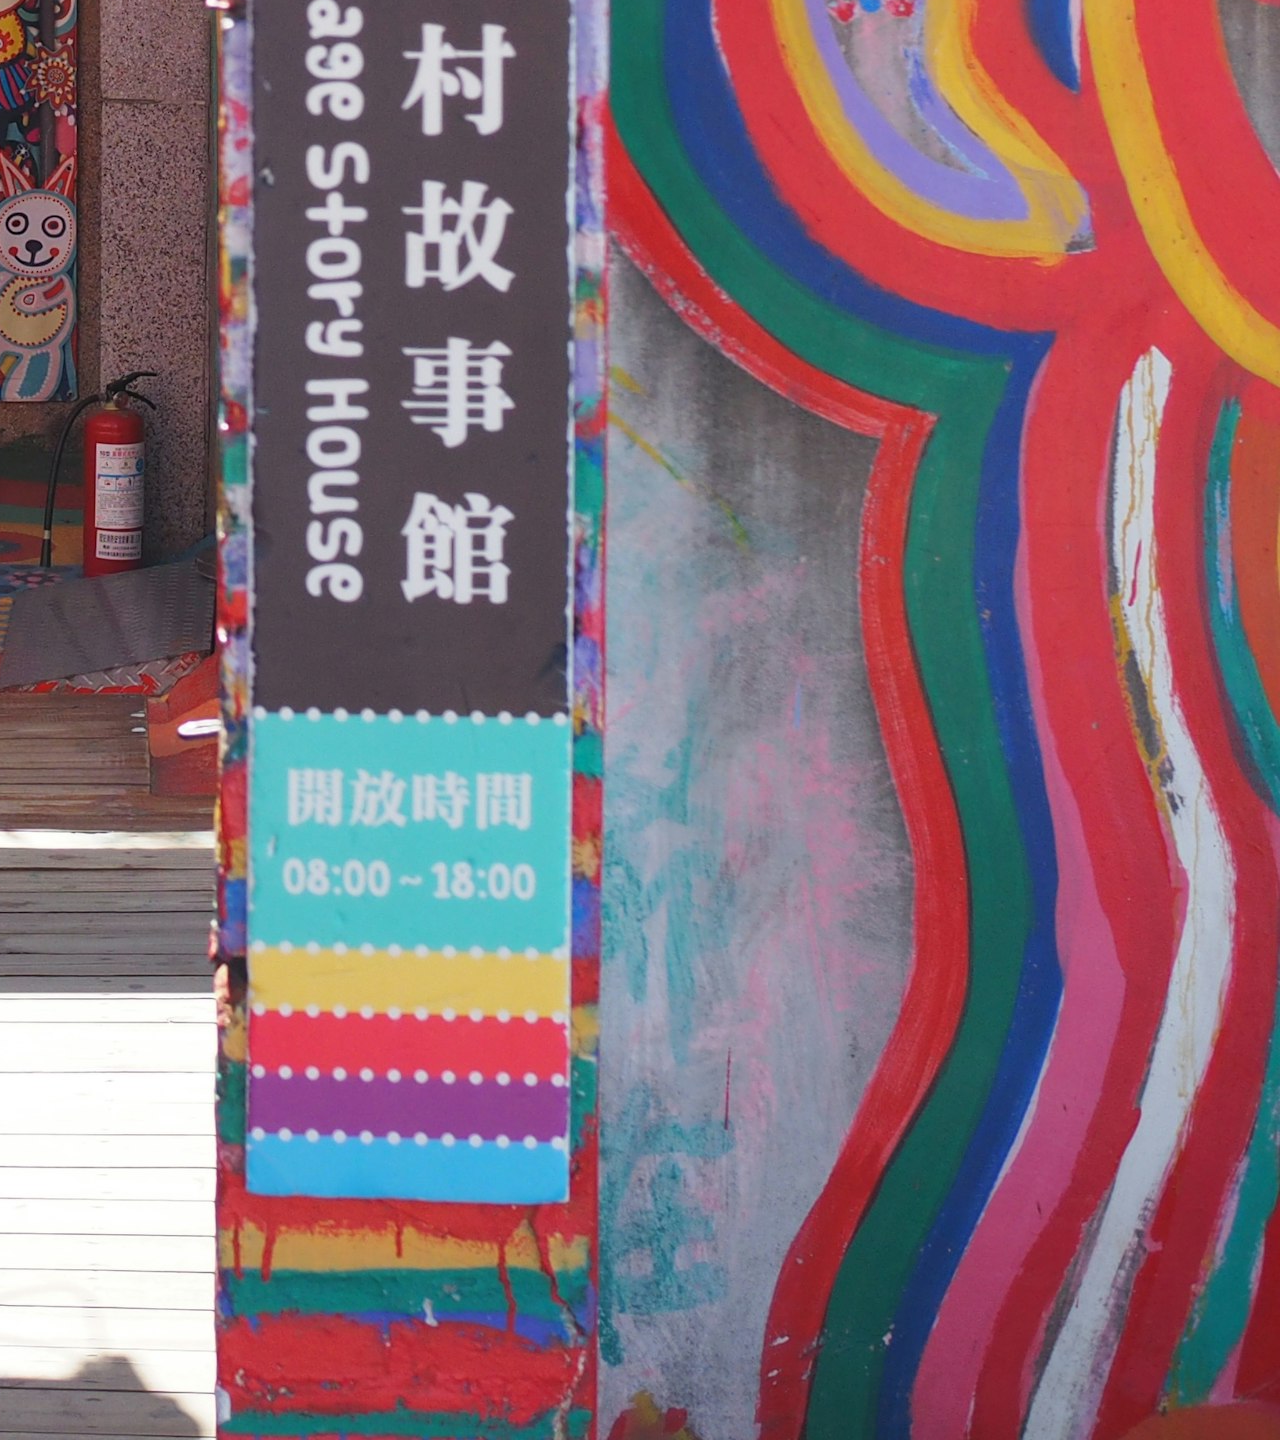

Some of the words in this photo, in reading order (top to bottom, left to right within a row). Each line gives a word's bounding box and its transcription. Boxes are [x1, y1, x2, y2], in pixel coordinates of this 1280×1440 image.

[304, 140, 371, 359] Story
[304, 377, 371, 603] House
[287, 768, 533, 831] 開放時間
[282, 858, 392, 898] 08:00
[431, 861, 537, 901] 18:00
